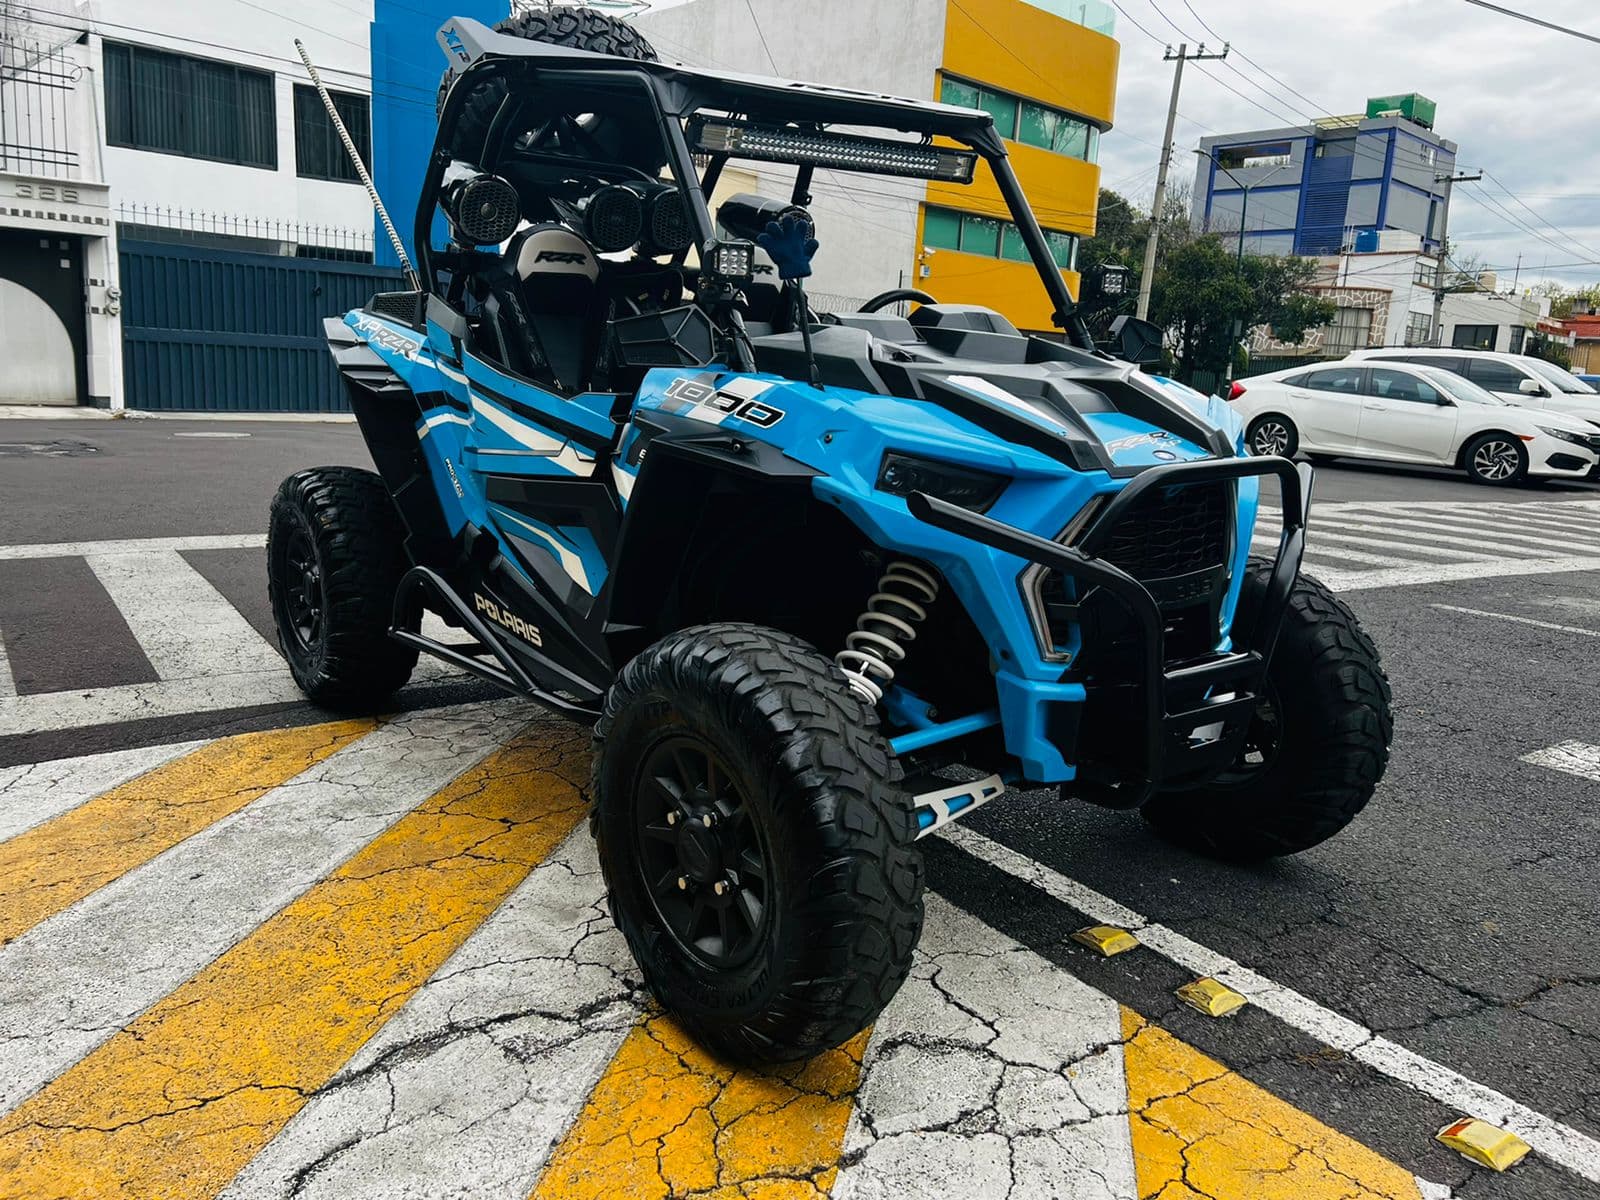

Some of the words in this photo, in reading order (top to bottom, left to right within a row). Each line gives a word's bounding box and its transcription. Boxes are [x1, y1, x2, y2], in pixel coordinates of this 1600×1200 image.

[441, 27, 471, 63] XP
[534, 251, 587, 265] RZR
[368, 326, 420, 359] RZR
[663, 377, 786, 429] 1000
[474, 592, 543, 648] POLARIS
